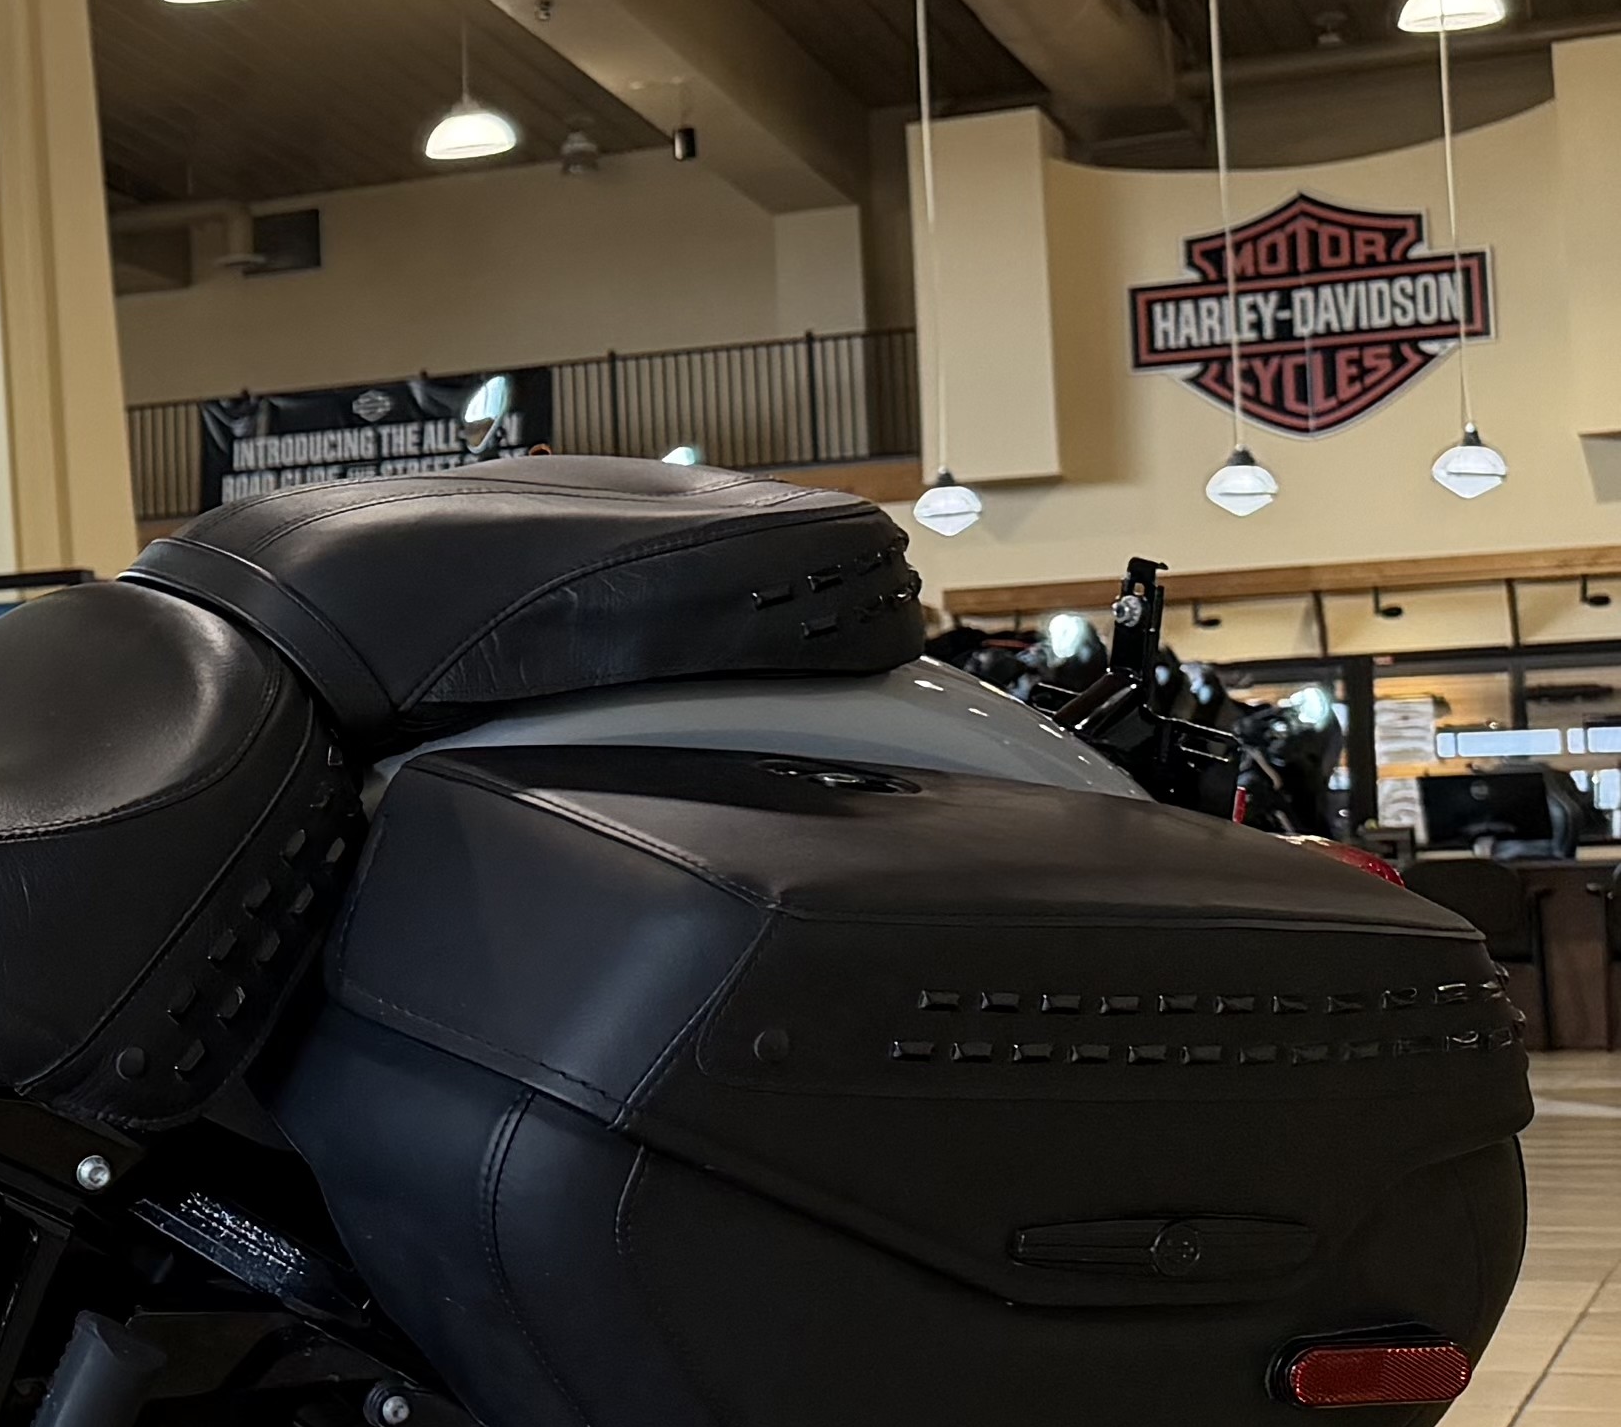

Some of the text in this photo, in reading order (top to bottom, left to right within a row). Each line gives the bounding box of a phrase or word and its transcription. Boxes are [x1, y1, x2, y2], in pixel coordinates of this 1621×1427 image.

[1223, 217, 1387, 277] MOTOR
[1151, 272, 1462, 351] HARLEY-DAVIDSON
[1225, 343, 1394, 414] CYCLES
[232, 426, 375, 471] INTRODUCING
[379, 420, 421, 459] THE
